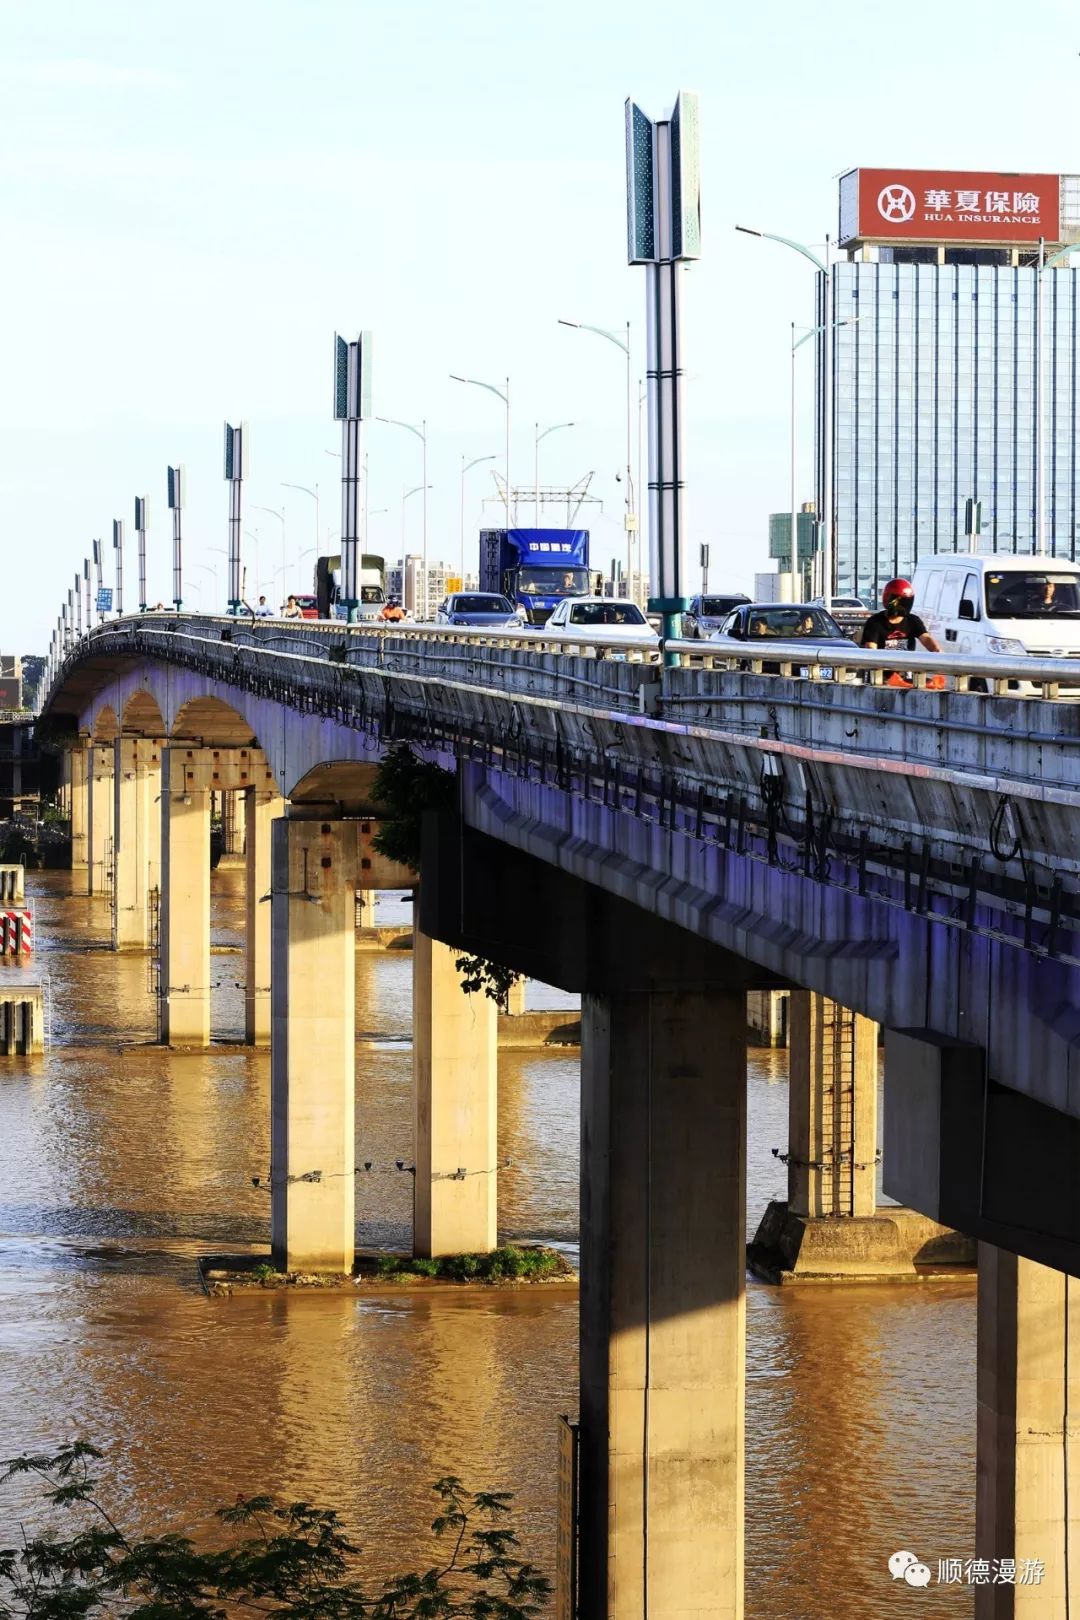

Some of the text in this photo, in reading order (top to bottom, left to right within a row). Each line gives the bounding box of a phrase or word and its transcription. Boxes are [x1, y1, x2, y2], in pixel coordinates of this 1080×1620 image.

[924, 189, 1040, 214] 華夏保險
[924, 213, 1041, 224] HUA INSURANCE
